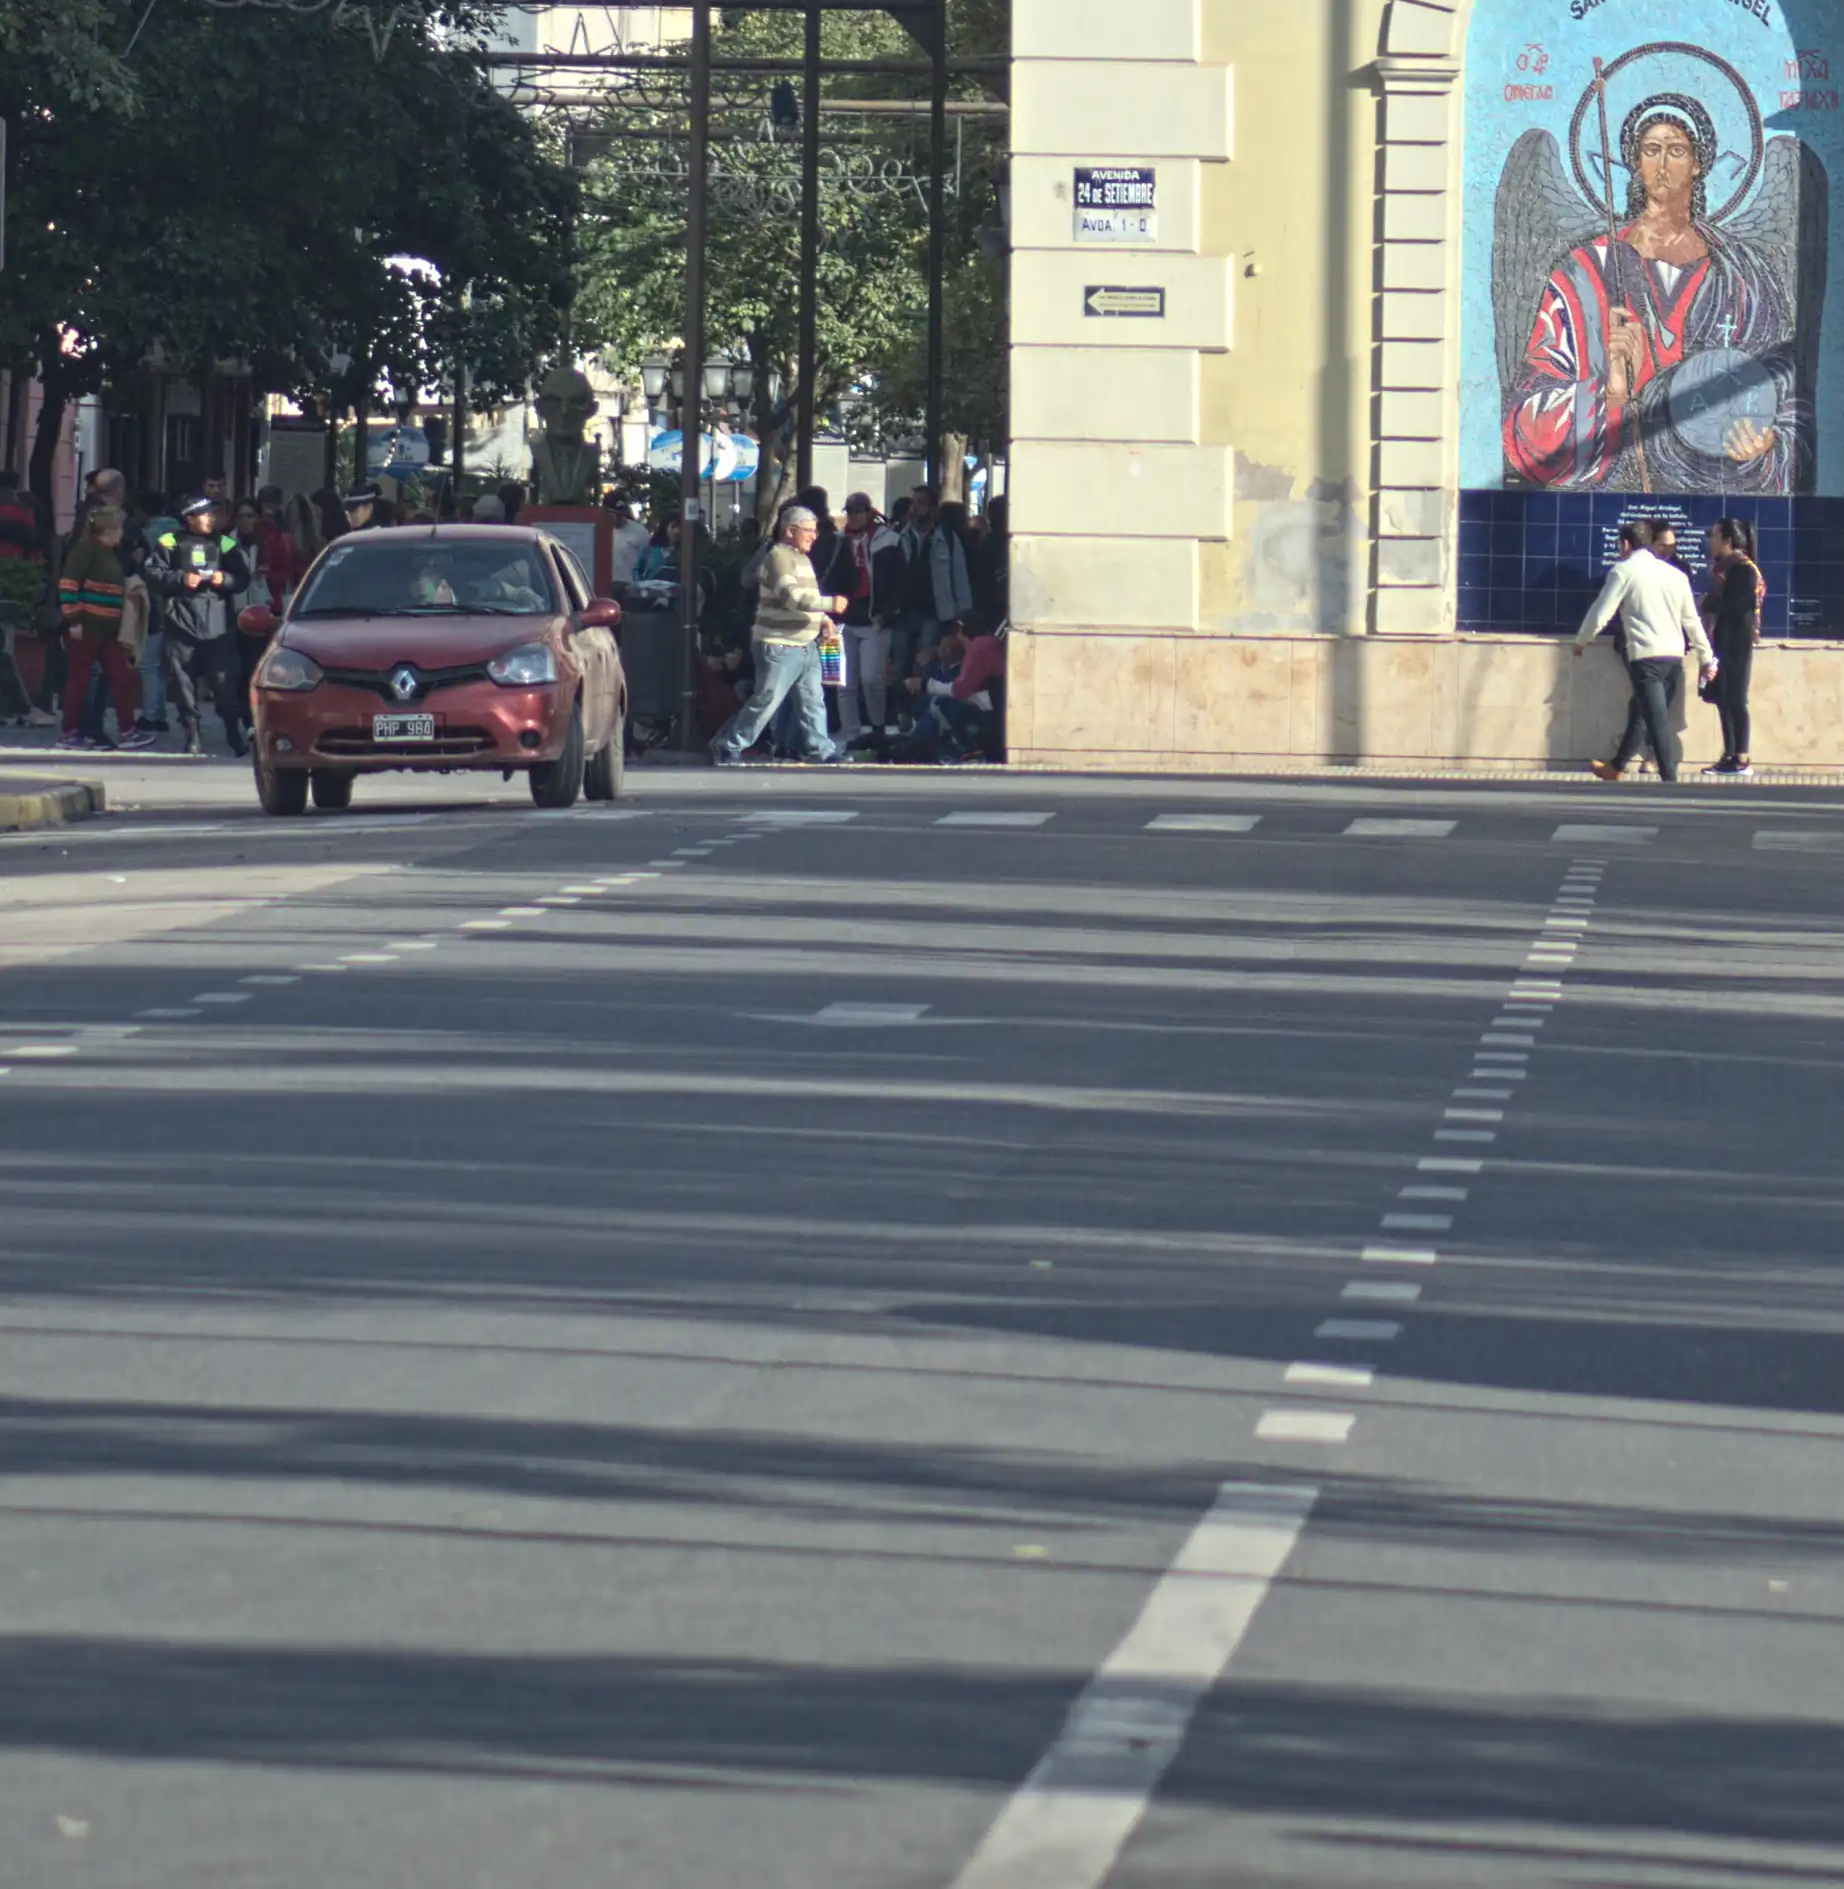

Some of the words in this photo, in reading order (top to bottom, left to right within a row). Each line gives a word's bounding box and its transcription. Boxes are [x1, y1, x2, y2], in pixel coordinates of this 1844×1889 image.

[1091, 170, 1140, 180] AVENIDA
[1077, 182, 1091, 203] 24
[1092, 188, 1103, 203] DE
[1104, 182, 1153, 204] SETIEMBRE
[375, 721, 400, 737] PHP
[407, 721, 431, 737] 984
